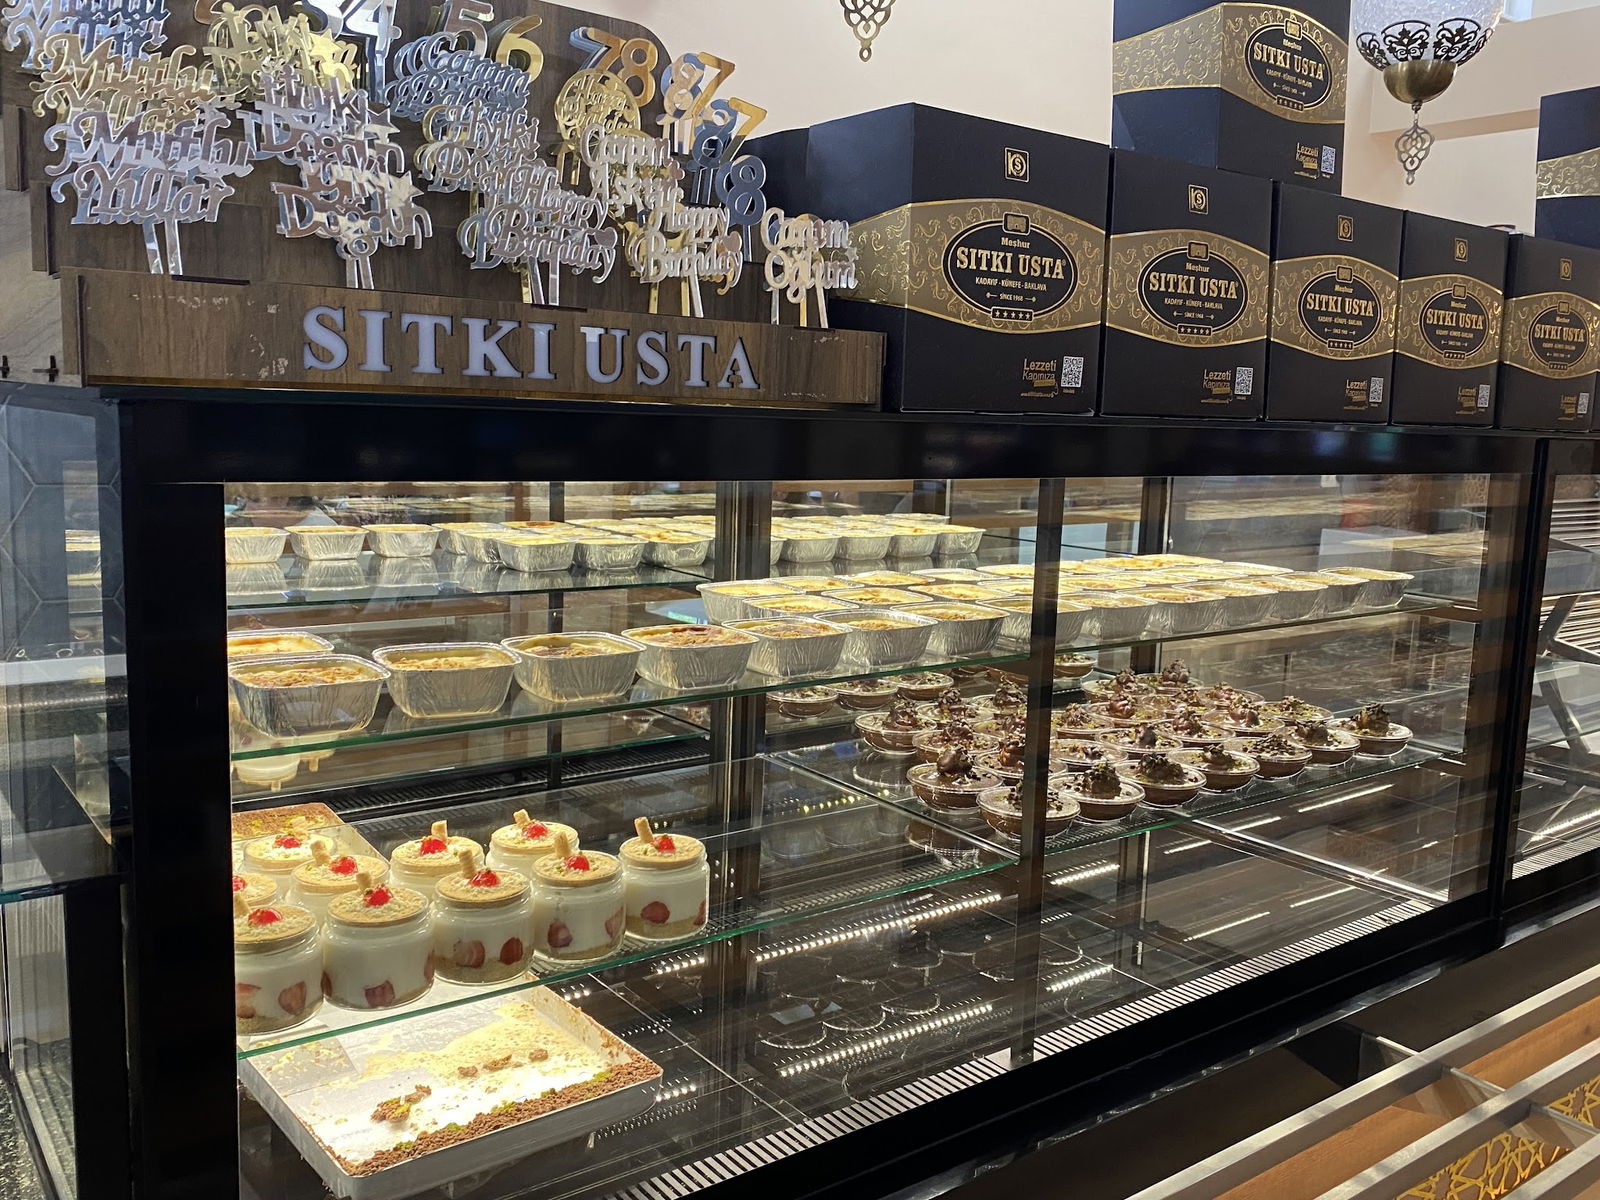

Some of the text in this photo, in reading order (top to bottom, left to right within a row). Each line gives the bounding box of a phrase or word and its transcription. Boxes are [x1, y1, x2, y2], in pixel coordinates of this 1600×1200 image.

[1253, 42, 1290, 70] SITKI
[1293, 54, 1324, 81] USTA
[956, 246, 1065, 280] SITKI USTA
[1149, 271, 1238, 299] SITKI USTA
[1306, 293, 1374, 317] SITKI USTA
[1426, 308, 1484, 330] SITKI USTA
[303, 305, 761, 389] SITKI USTA
[1024, 358, 1057, 372] Lezzeti
[1203, 369, 1231, 381] Lezzeti
